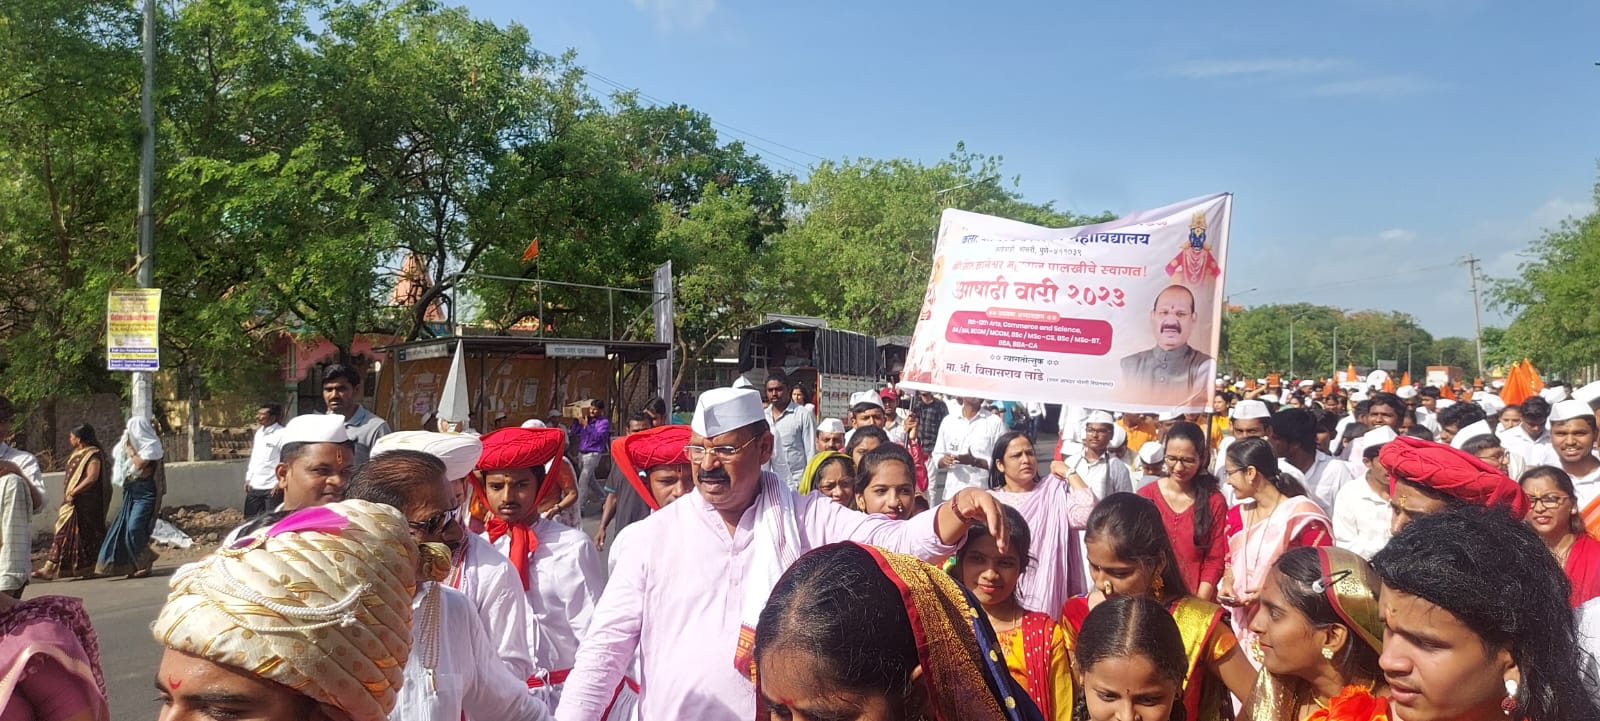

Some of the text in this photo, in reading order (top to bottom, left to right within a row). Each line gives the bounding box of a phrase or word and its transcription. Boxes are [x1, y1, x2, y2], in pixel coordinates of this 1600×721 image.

[1048, 260, 1098, 275] पालखीचे
[1101, 265, 1147, 277] स्वागत!
[952, 274, 1125, 308] आषाढी वारी २०२३
[1003, 321, 1039, 330] Commerce
[1054, 325, 1082, 334] Science,
[975, 363, 1022, 378] विलासराव
[1024, 368, 1045, 382] लांडे
